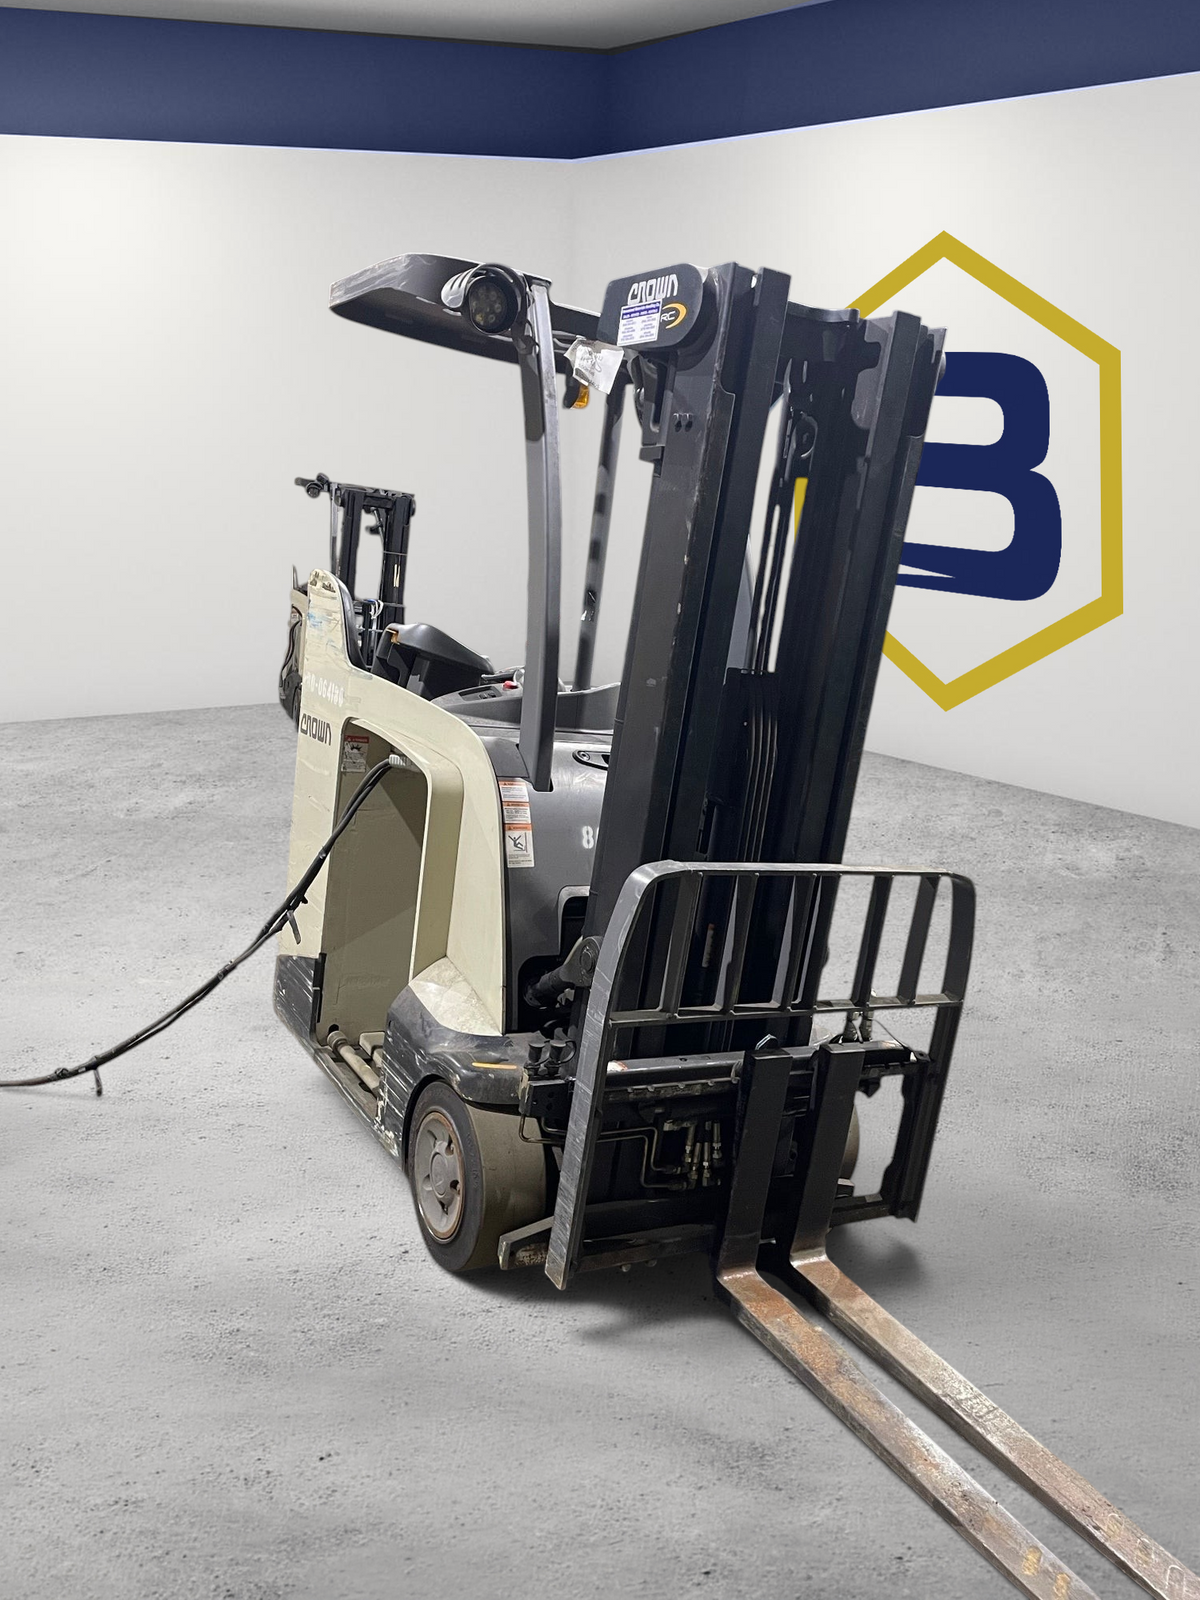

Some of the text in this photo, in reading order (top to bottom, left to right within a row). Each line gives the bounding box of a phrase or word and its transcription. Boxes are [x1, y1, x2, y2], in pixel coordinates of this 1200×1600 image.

[627, 273, 679, 306] CROWN
[660, 310, 676, 322] RC
[895, 351, 1063, 602] B
[300, 713, 332, 747] CROWN
